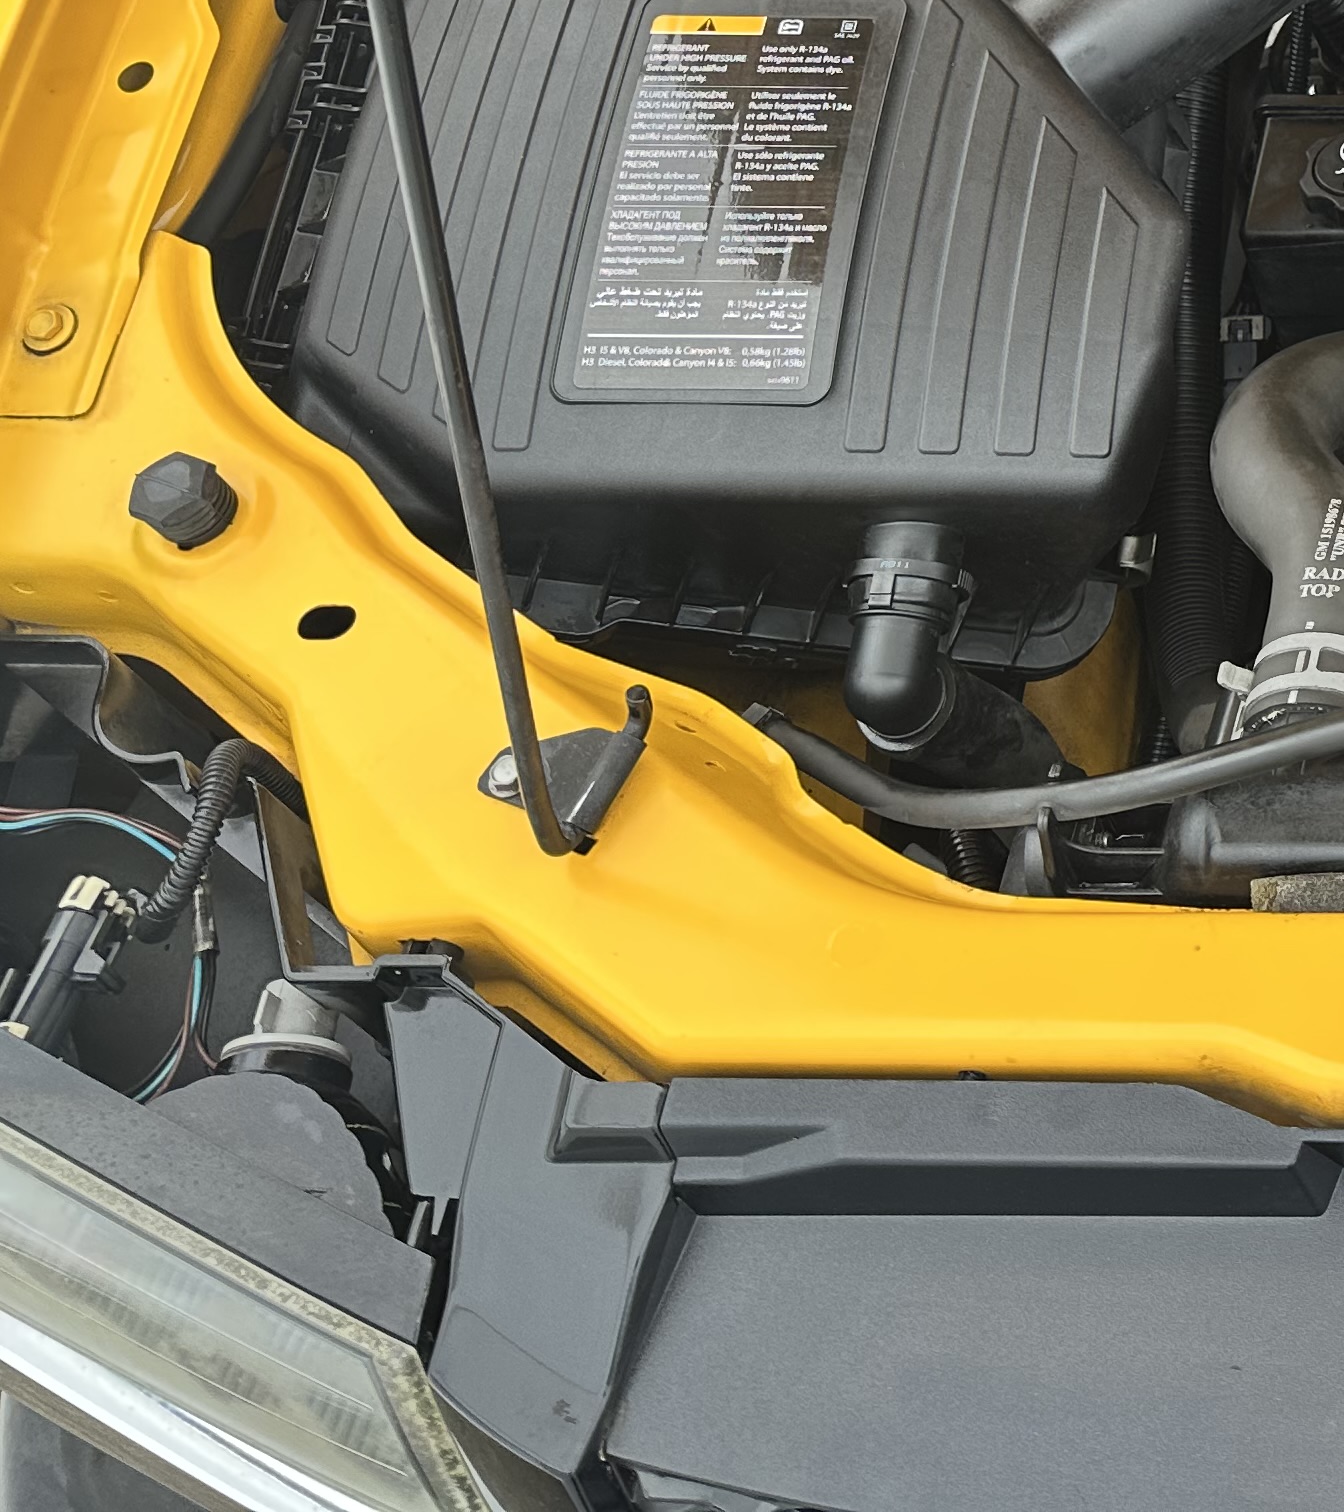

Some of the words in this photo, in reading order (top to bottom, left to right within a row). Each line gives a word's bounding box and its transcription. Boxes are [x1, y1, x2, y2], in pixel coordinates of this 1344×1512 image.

[779, 46, 798, 54] only
[760, 56, 804, 64] refrigerant
[678, 65, 689, 73] by
[690, 65, 727, 73] qualified
[757, 65, 787, 74] System
[826, 66, 843, 75] dye.
[782, 92, 826, 100] seulement
[828, 92, 836, 100] le
[823, 103, 852, 111] R-134a
[667, 123, 681, 131] par
[696, 123, 739, 131] personnel
[624, 150, 688, 158] REFRIGERANTE
[689, 150, 696, 158] A
[697, 150, 718, 158] ALTA
[774, 152, 825, 161] refrigerante
[735, 162, 764, 170] R-134a
[800, 162, 819, 170] PAG.
[620, 171, 628, 179] El
[742, 173, 775, 181] sistema
[776, 173, 814, 181] contiene
[610, 210, 661, 219] ХЛАДАГЕНТ
[662, 211, 681, 220] ПОД
[764, 224, 794, 232] R-134a
[584, 346, 596, 354] H3
[634, 346, 673, 354] Colorado
[683, 347, 716, 356] Canyon
[582, 358, 594, 366] H3
[673, 359, 705, 369] Canyon
[773, 359, 805, 368] (1.45lb)
[1315, 541, 1329, 560] GM
[1300, 584, 1340, 598] TOP
